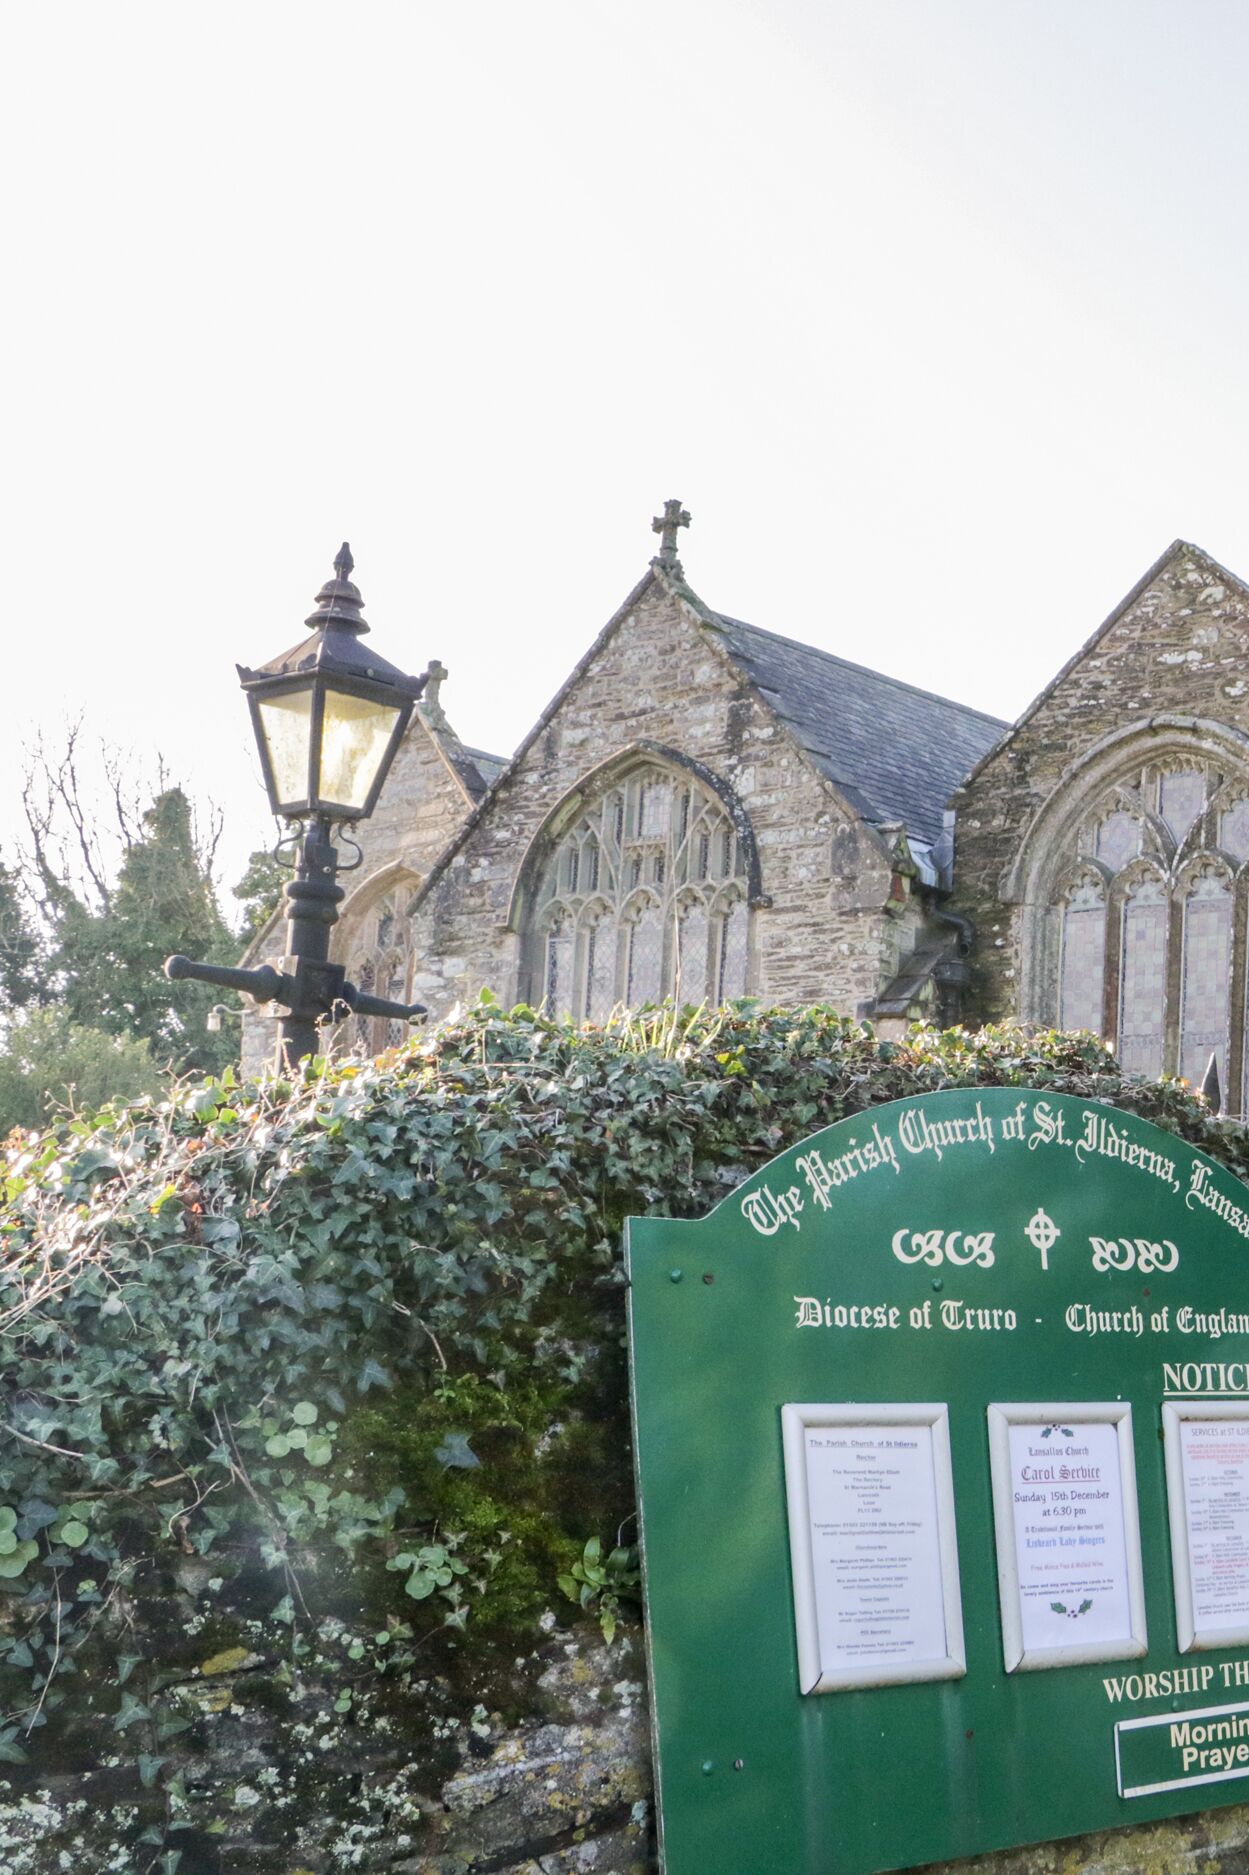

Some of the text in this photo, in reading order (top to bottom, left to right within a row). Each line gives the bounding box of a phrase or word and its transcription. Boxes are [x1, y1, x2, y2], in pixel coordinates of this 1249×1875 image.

[741, 1184, 804, 1236] The
[795, 1123, 899, 1211] Parish
[898, 1101, 995, 1162] Church
[1002, 1101, 1027, 1141] of
[1028, 1101, 1073, 1150] St.
[1075, 1110, 1180, 1193] Ildierna,
[793, 1296, 900, 1329] Diocese
[909, 1300, 932, 1329] of
[940, 1300, 1017, 1331] Truro
[1065, 1303, 1144, 1337] Church
[1151, 1306, 1170, 1333] of
[1028, 1446, 1089, 1456] Lansallos Church
[1021, 1465, 1100, 1481] Carol Service
[1015, 1490, 1110, 1503] Sunday 15th December
[1042, 1508, 1050, 1517] at
[1074, 1508, 1087, 1517] pm
[1103, 1665, 1214, 1703] WORSHIP
